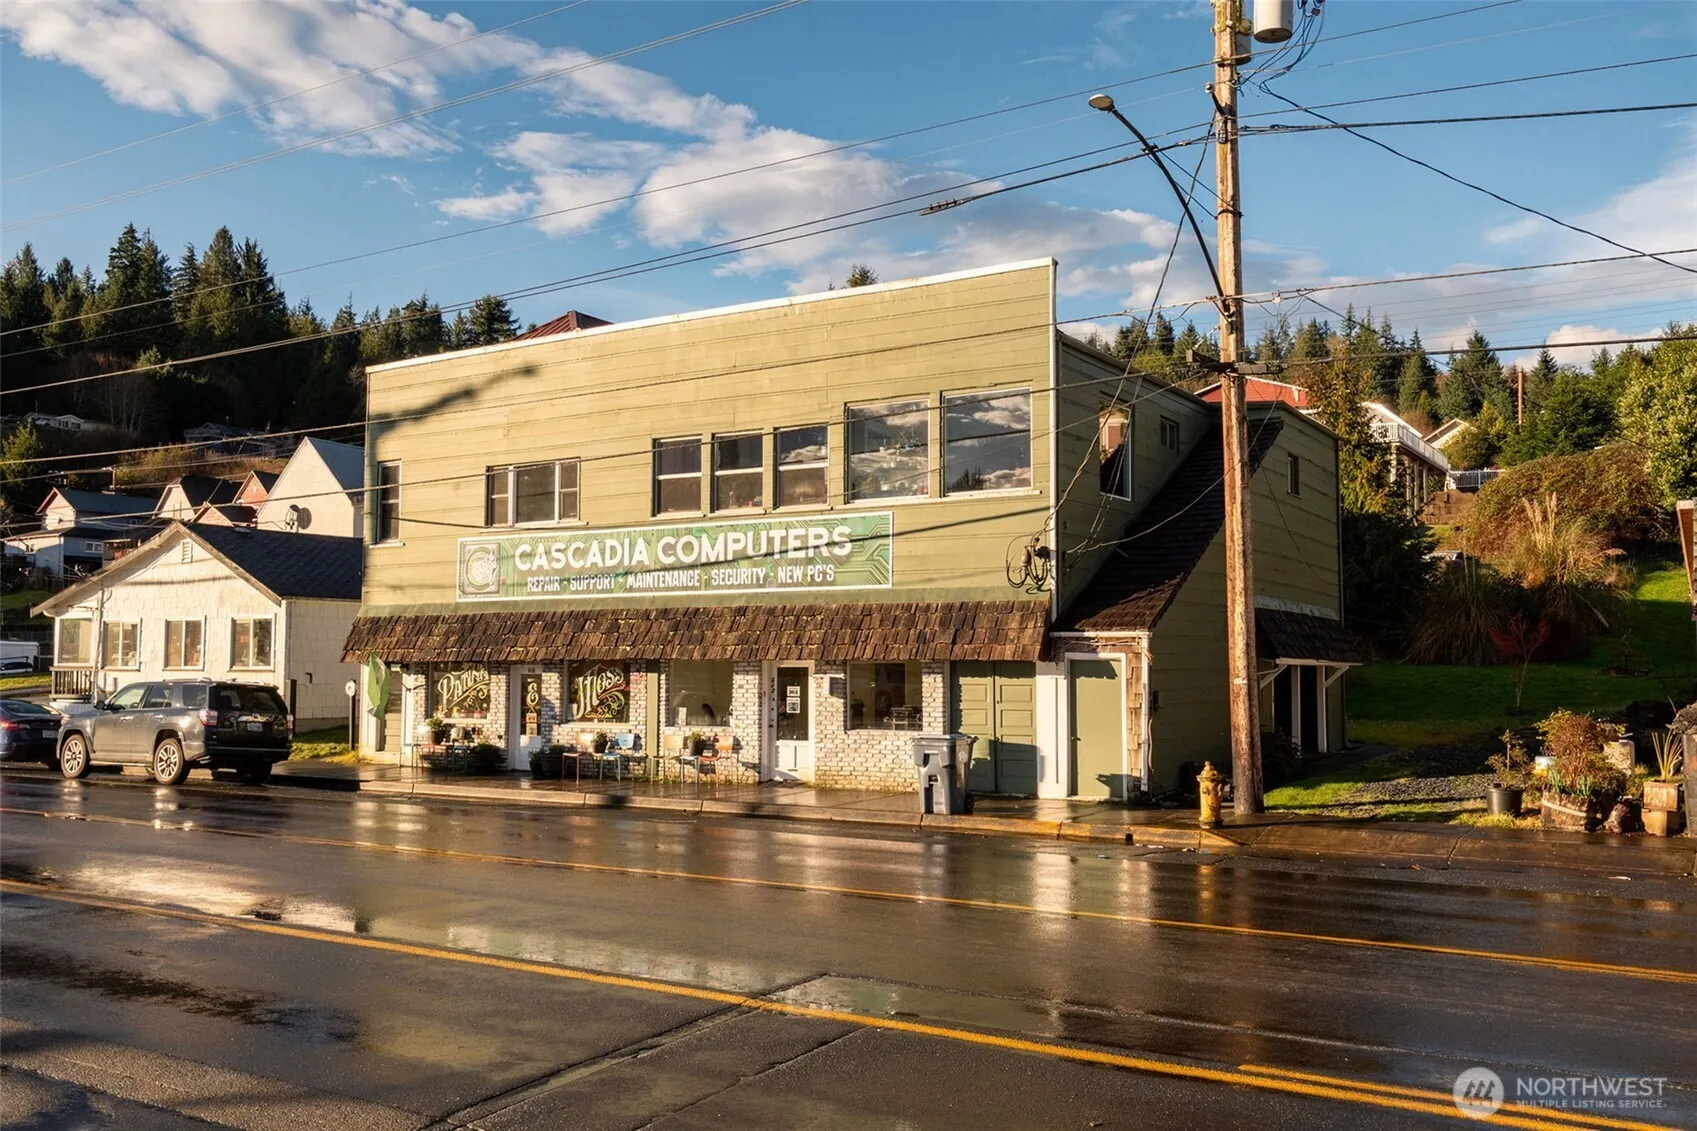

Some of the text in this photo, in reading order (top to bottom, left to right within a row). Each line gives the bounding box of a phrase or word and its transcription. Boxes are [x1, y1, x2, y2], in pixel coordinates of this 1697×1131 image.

[514, 525, 853, 571] CASCADIA COMPUTERS
[527, 563, 835, 592] REPAIR SUPPORT MAINTENANCE SECURITY NEW PC'S
